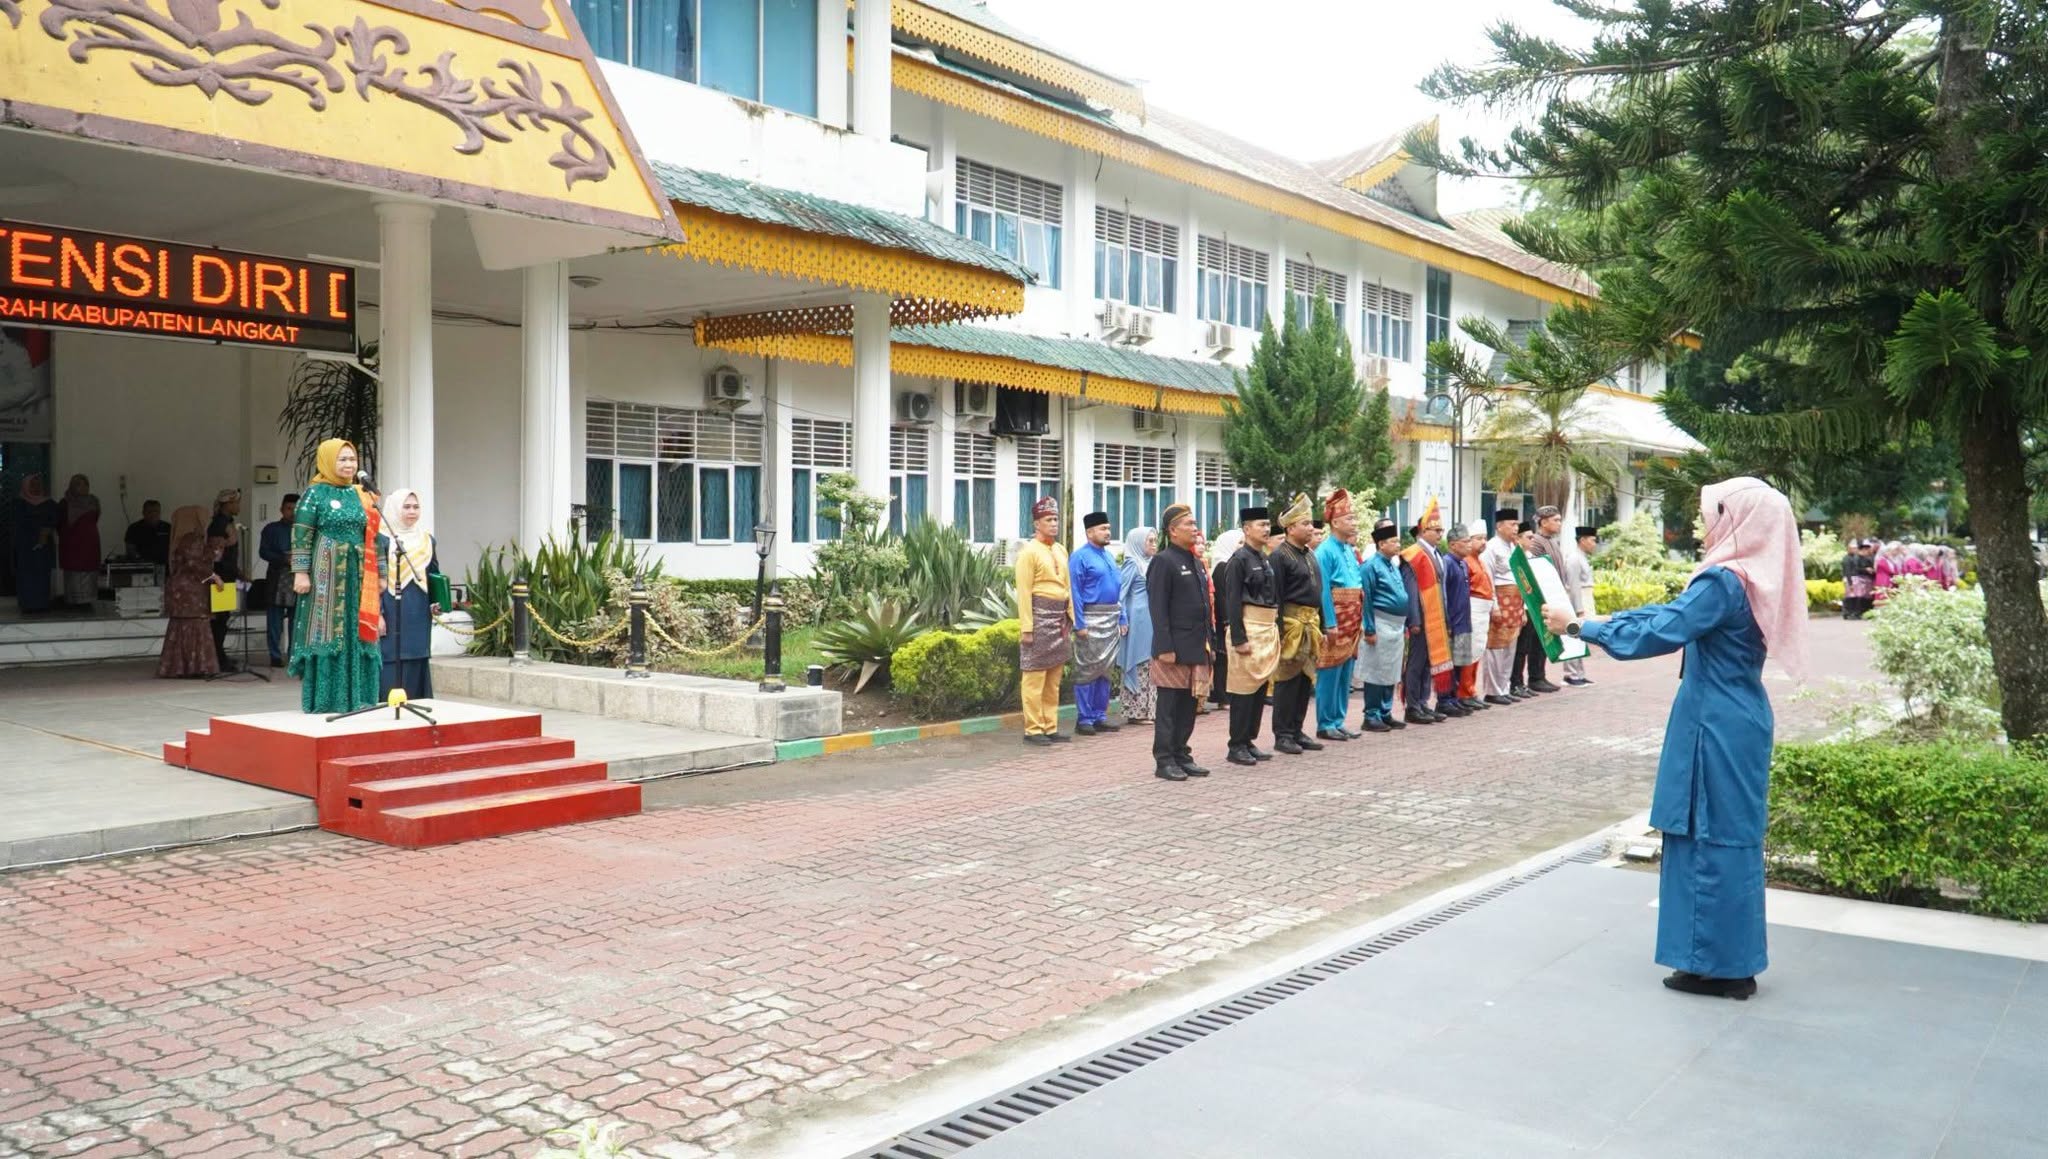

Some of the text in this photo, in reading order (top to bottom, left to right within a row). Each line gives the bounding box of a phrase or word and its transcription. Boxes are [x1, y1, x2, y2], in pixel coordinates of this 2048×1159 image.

[192, 254, 309, 314] DIRI
[52, 302, 193, 332] KABUPATEN
[198, 317, 300, 343] LANGKAT
